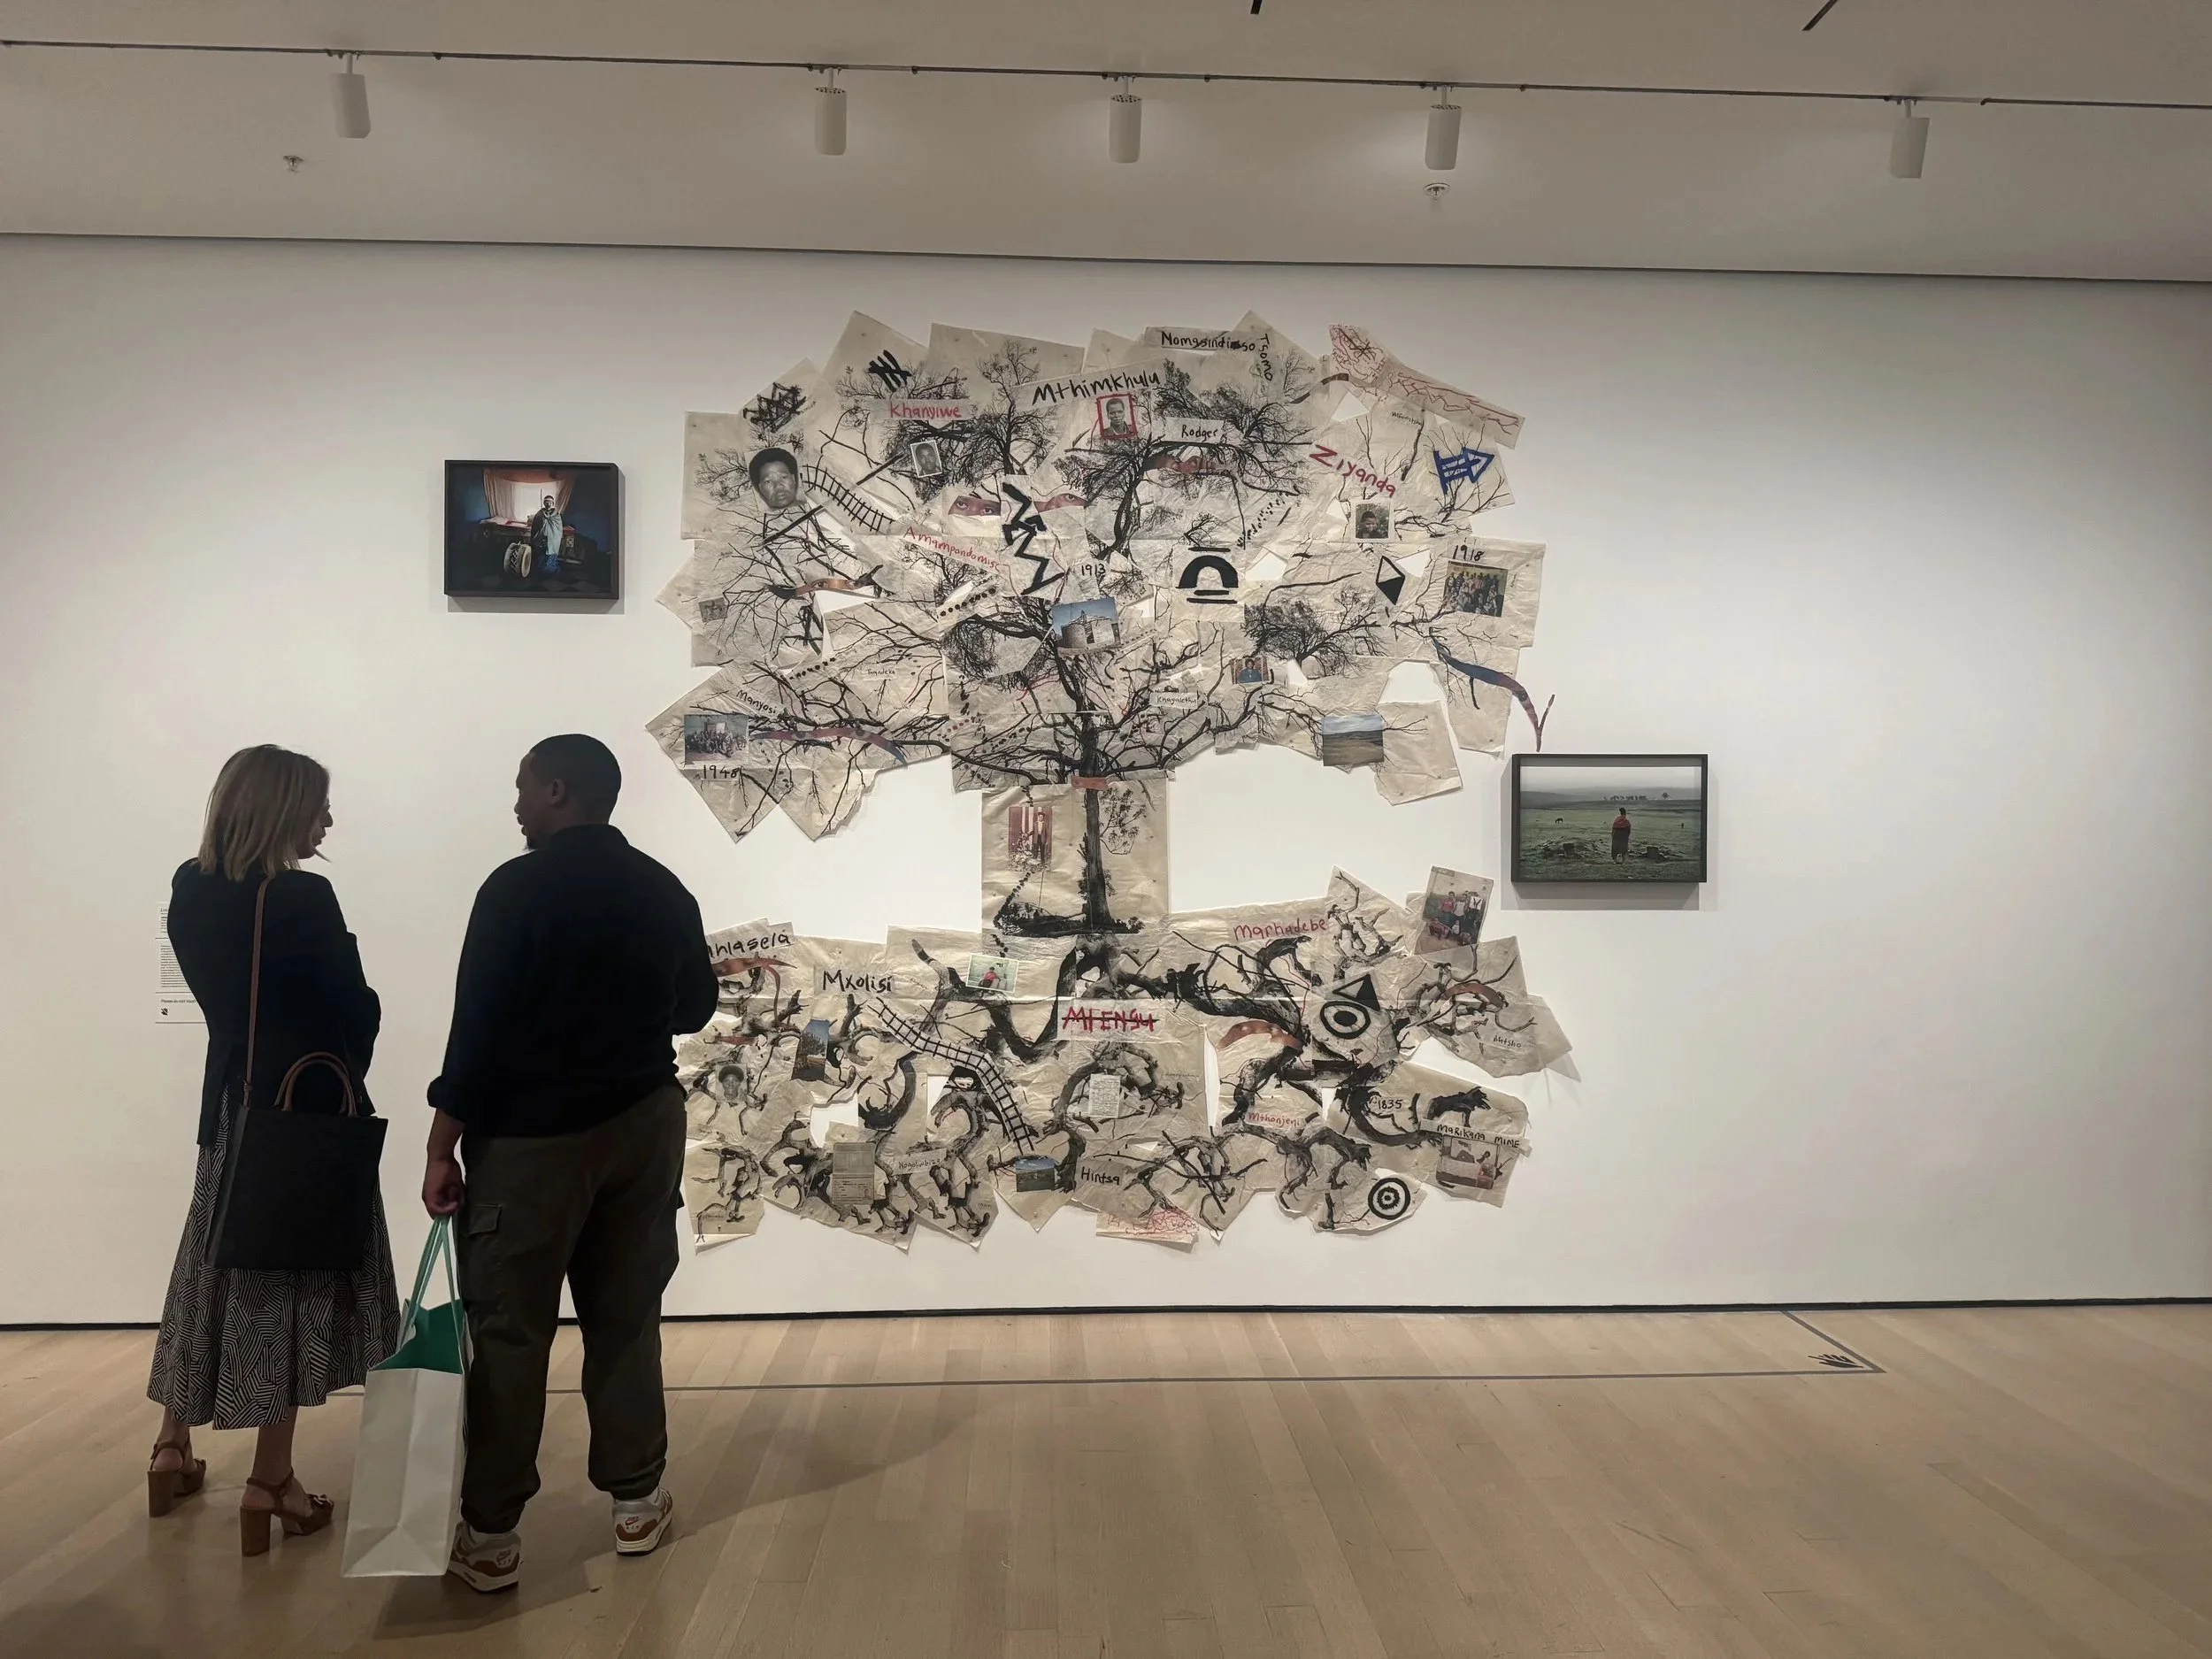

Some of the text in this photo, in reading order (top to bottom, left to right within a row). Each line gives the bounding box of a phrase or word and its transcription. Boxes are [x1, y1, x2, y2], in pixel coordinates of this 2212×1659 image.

[1032, 370, 1161, 406] Mthimkhulu
[890, 402, 962, 420] Khanyiwe
[1181, 424, 1218, 442] Rodger
[1453, 544, 1486, 562] 1918
[1081, 563, 1106, 577] 1913
[703, 764, 741, 780] 1948
[822, 969, 893, 994] Mxolisi
[1378, 1099, 1404, 1110] 1835
[1248, 1112, 1300, 1128] Mthonjeni
